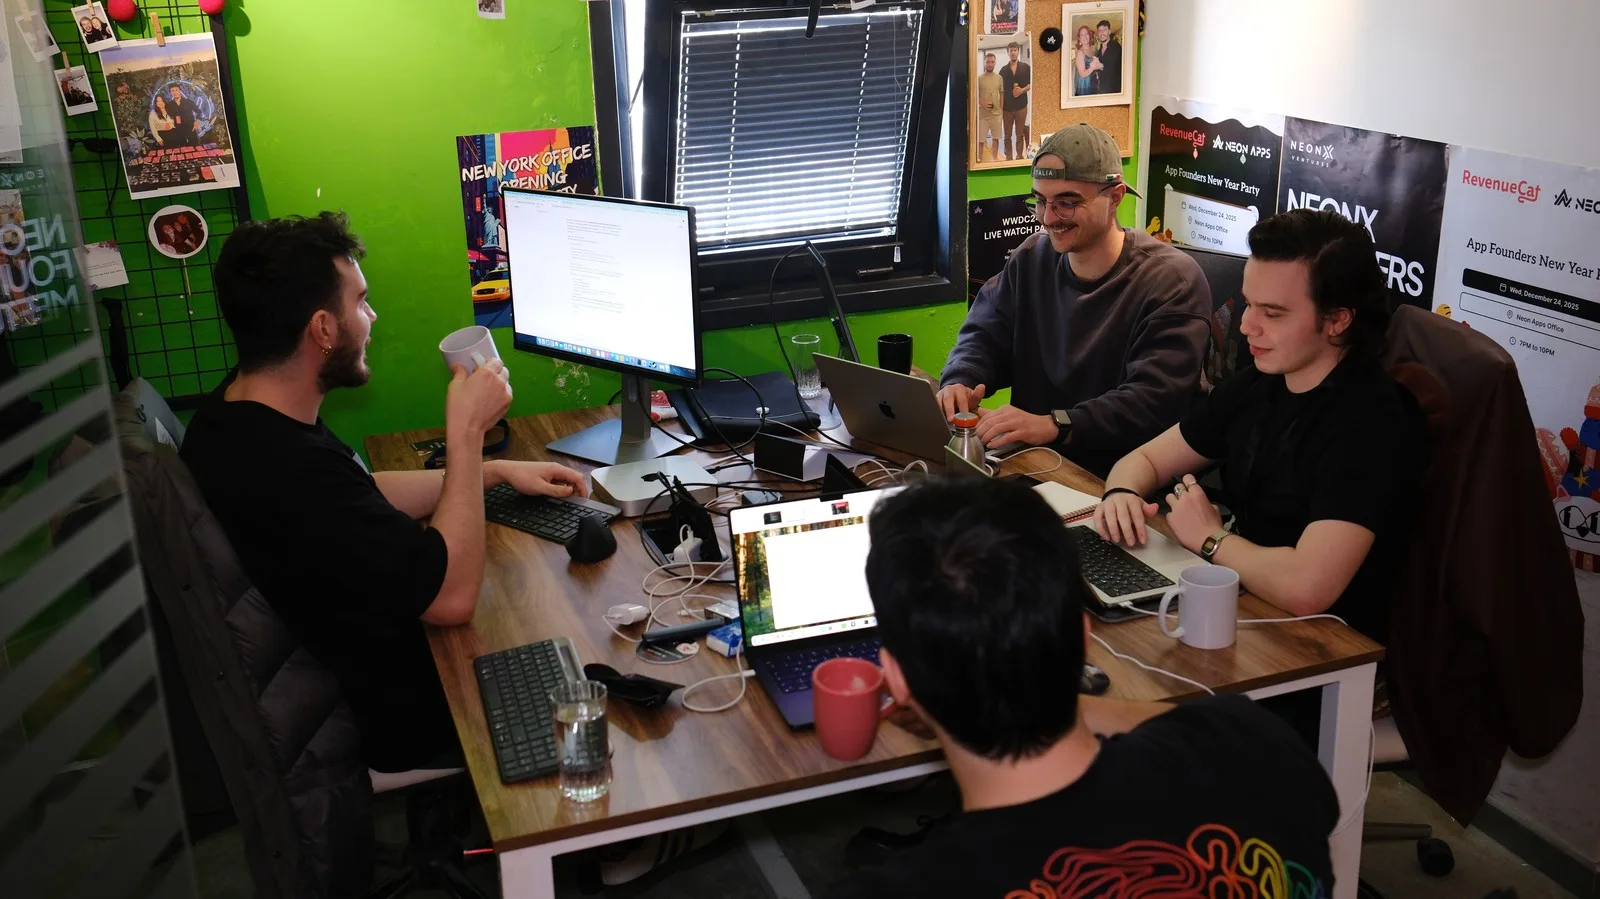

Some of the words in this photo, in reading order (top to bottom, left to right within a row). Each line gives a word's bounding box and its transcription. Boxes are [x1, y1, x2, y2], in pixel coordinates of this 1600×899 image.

[1160, 123, 1206, 148] RevenueCat
[1225, 141, 1248, 155] NEON
[1250, 146, 1271, 159] APPS
[462, 164, 496, 182] NEW
[499, 156, 540, 176] YORK
[542, 144, 592, 165] OFFICE
[1291, 155, 1329, 168] VENTURES
[1165, 164, 1178, 177] App
[1179, 167, 1206, 183] Founders
[1207, 174, 1223, 187] New
[1224, 178, 1240, 191] Year
[1240, 182, 1260, 197] Party
[1462, 169, 1541, 203] RevenueCat
[1002, 214, 1037, 226] WWDC2
[1198, 206, 1218, 217] December
[1225, 213, 1237, 222] 2025
[984, 230, 1001, 240] LIVE
[1003, 225, 1033, 237] WATCH
[1194, 219, 1204, 227] Neon
[1205, 222, 1215, 231] Apps
[1216, 225, 1228, 234] Office
[1466, 237, 1487, 254] App
[1489, 242, 1537, 265] Founders
[1539, 254, 1565, 271] New
[1568, 261, 1594, 279] Year
[1523, 290, 1553, 304] December
[1563, 301, 1580, 311] 2025
[1516, 313, 1531, 324] Neon
[1531, 318, 1546, 329] Apps
[1547, 322, 1565, 333] Office
[1519, 340, 1531, 350] 7PM
[1532, 342, 1538, 352] to
[1539, 346, 1555, 356] 10PM
